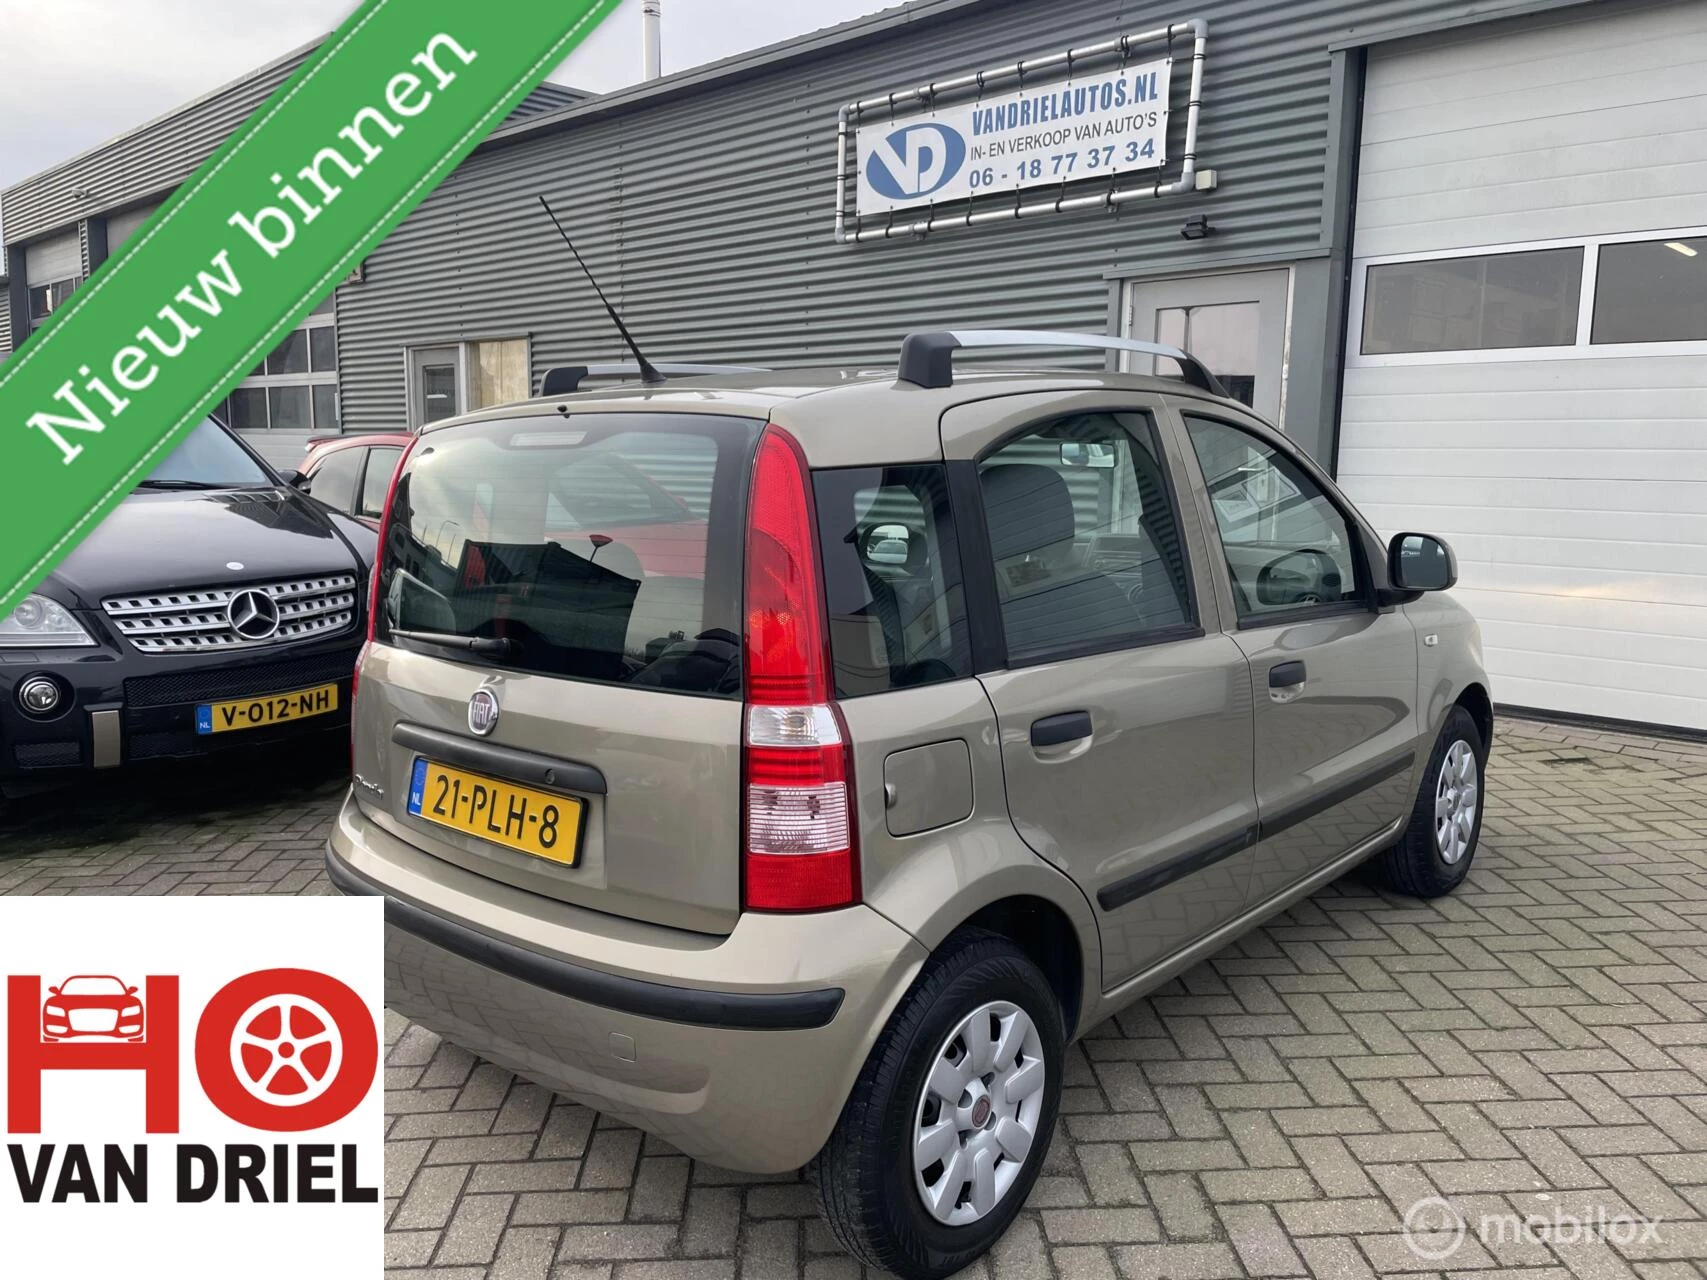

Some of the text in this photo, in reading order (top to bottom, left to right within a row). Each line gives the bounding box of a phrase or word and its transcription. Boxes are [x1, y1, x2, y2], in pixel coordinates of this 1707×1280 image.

[972, 72, 1158, 136] VANDRIELAUTOS.NL
[970, 111, 1157, 161] IN- EN VERKOOP VAN AUTO'S
[969, 167, 993, 189] 06
[1017, 159, 1042, 180] 18
[1051, 152, 1078, 174] 77
[1087, 145, 1116, 168] 37
[1125, 138, 1155, 161] 34
[222, 689, 329, 727] V-012-NH
[472, 701, 490, 725] FIAT
[411, 791, 421, 806] NL
[433, 775, 559, 848] 21-PLH-8
